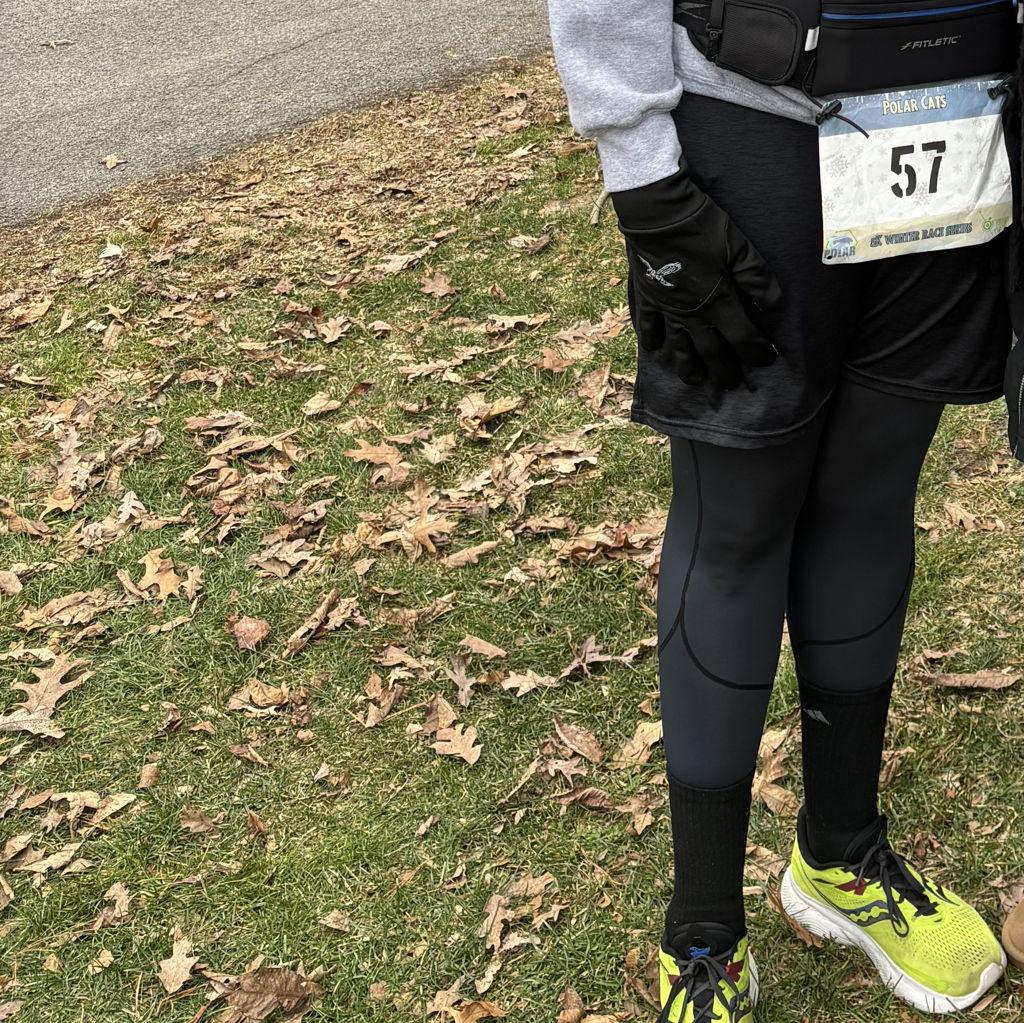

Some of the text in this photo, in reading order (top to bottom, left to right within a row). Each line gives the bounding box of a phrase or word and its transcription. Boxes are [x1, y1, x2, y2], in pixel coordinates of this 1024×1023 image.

[911, 36, 958, 50] FITLETIC
[882, 95, 947, 116] POLAR CATS
[890, 140, 946, 199] 57
